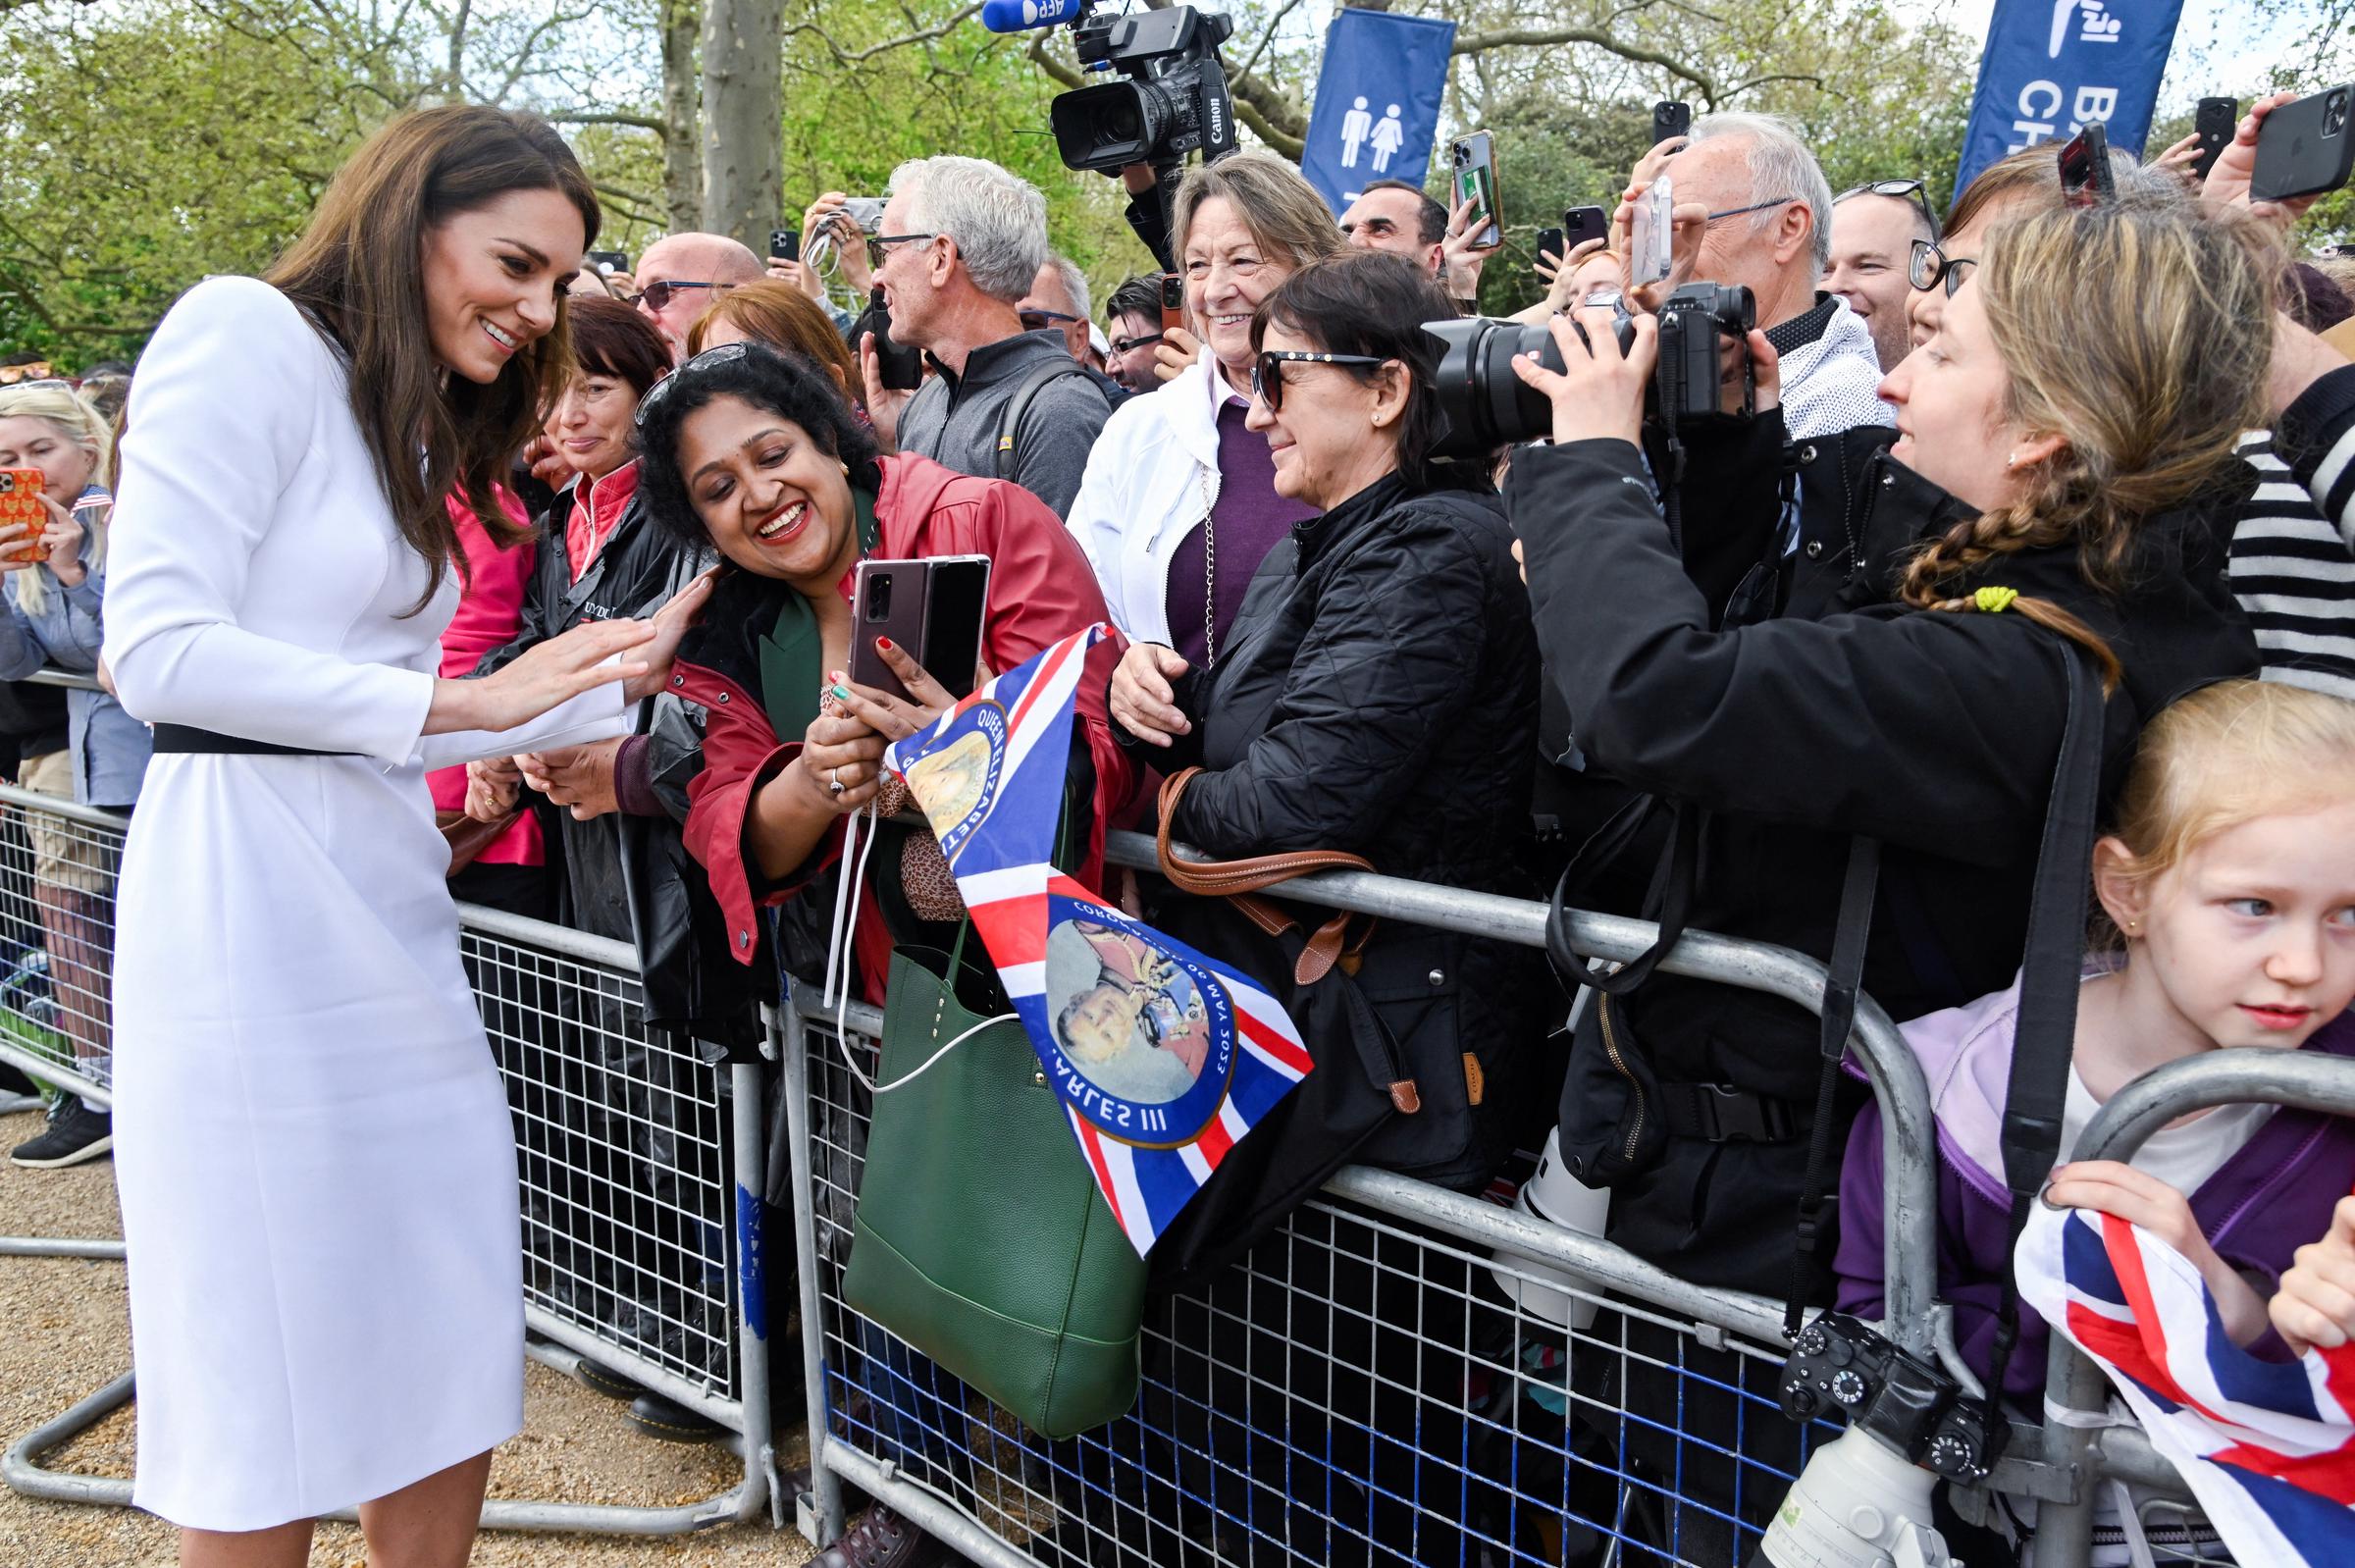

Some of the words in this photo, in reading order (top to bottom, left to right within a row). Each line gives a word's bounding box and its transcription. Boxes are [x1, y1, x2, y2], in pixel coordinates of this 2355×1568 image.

[1039, 0, 1065, 19] AFP
[1211, 98, 1223, 144] Canon
[977, 709, 1004, 748] QUEEN
